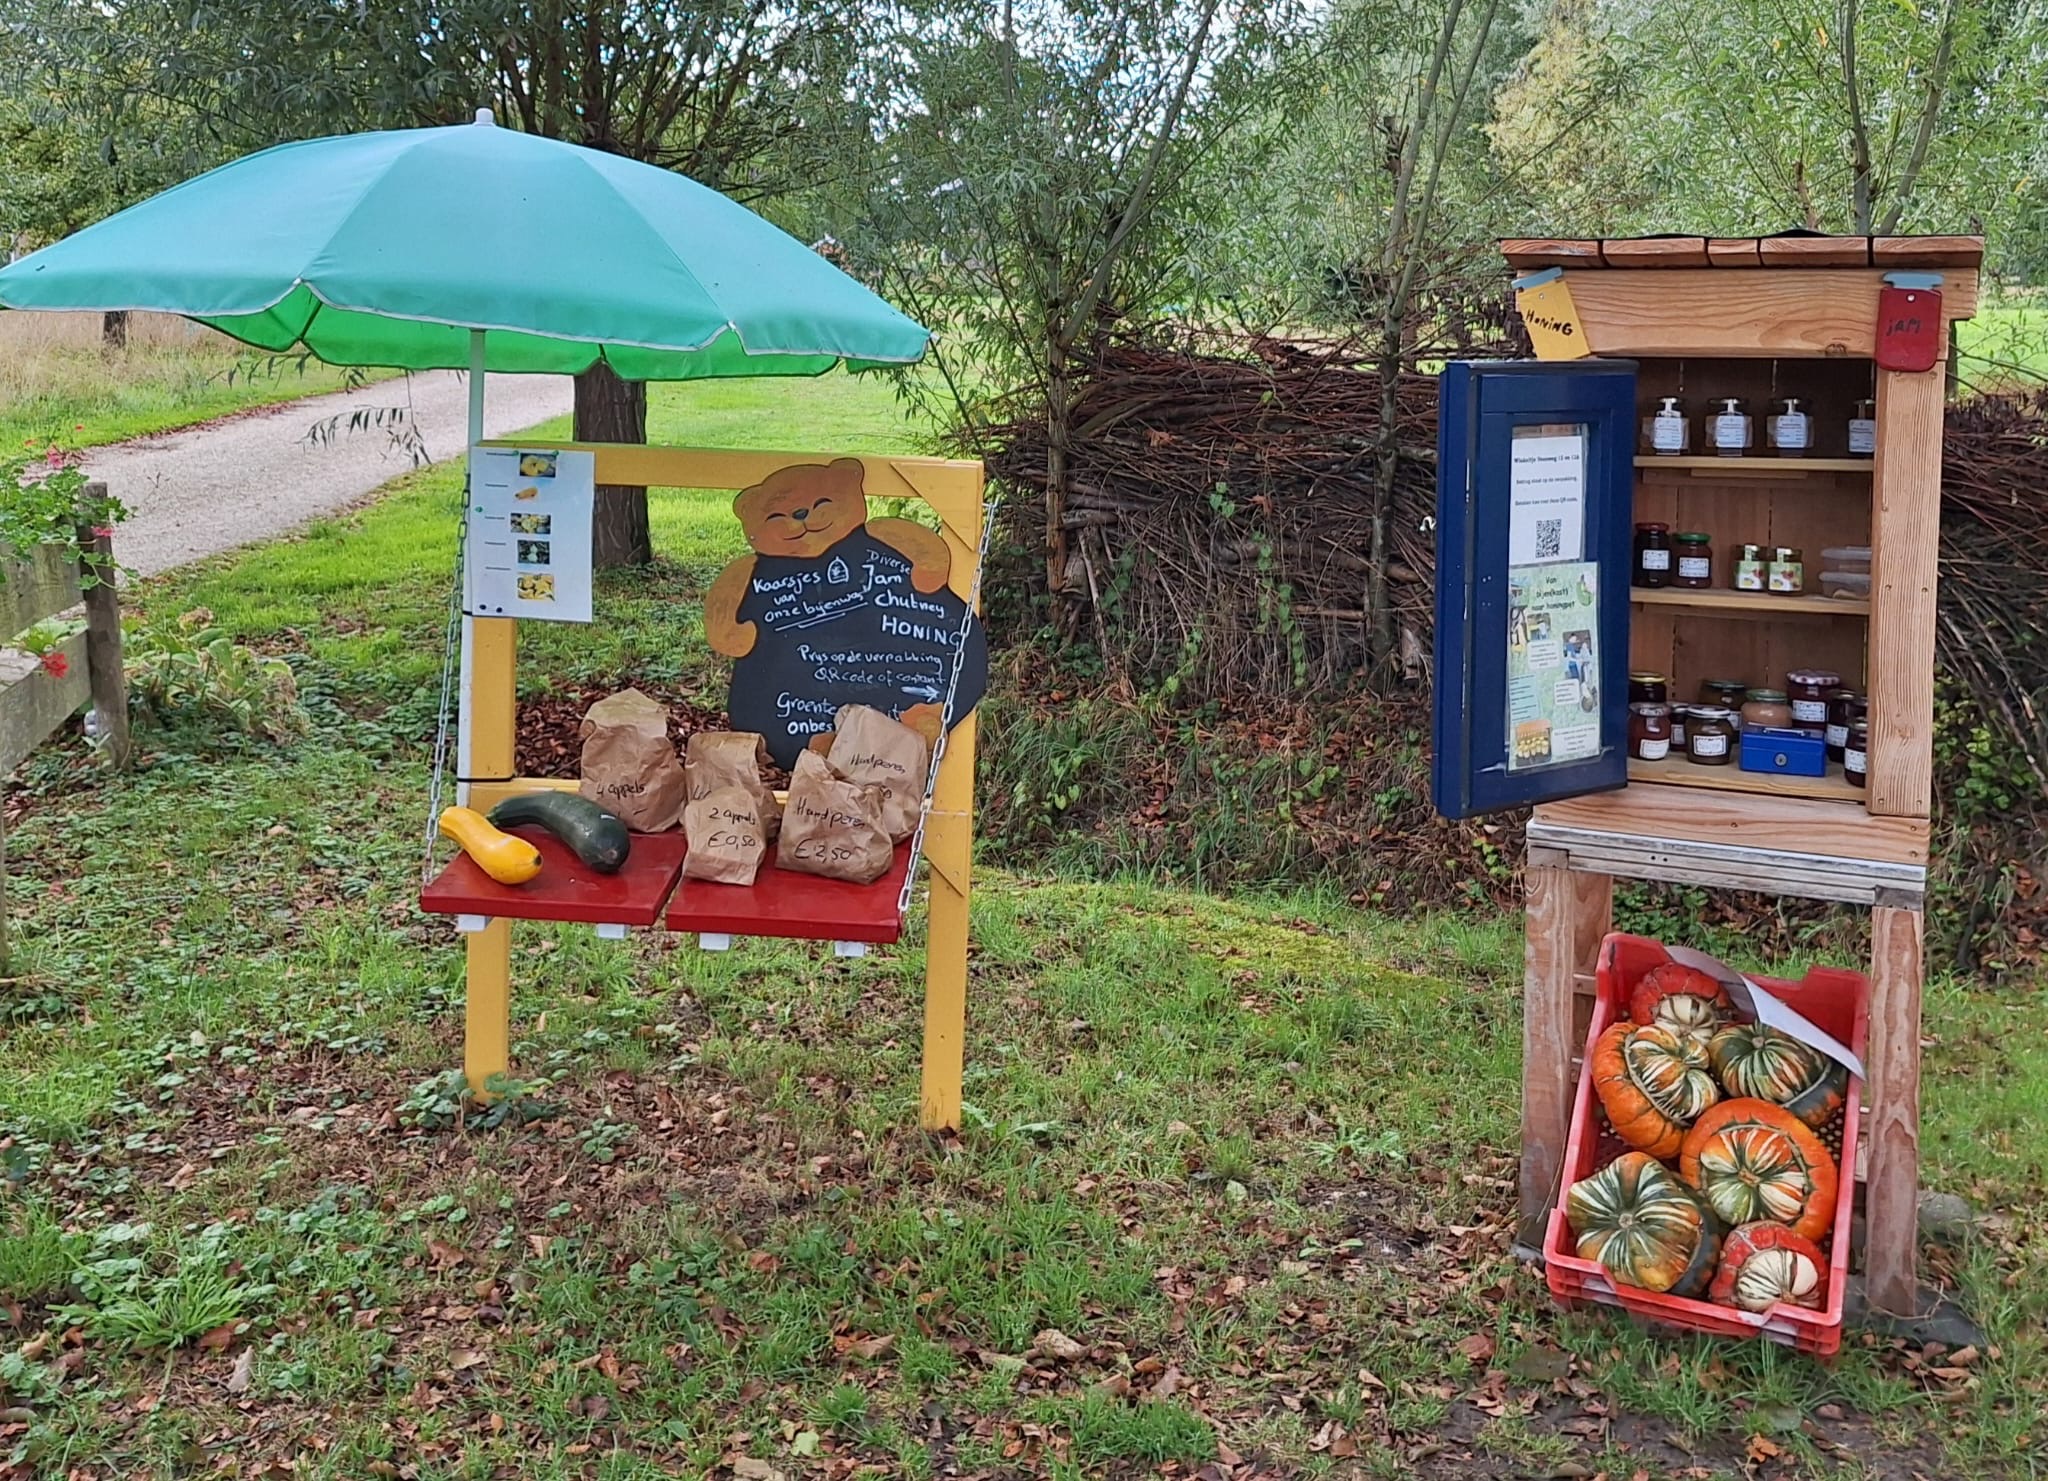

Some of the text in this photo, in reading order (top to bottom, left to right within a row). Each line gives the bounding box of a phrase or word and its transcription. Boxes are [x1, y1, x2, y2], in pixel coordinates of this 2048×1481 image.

[862, 564, 902, 592] Jam
[774, 593, 796, 605] van
[814, 666, 841, 684] QR
[878, 670, 892, 687] of
[787, 718, 833, 735] onbes
[709, 807, 721, 819] 2
